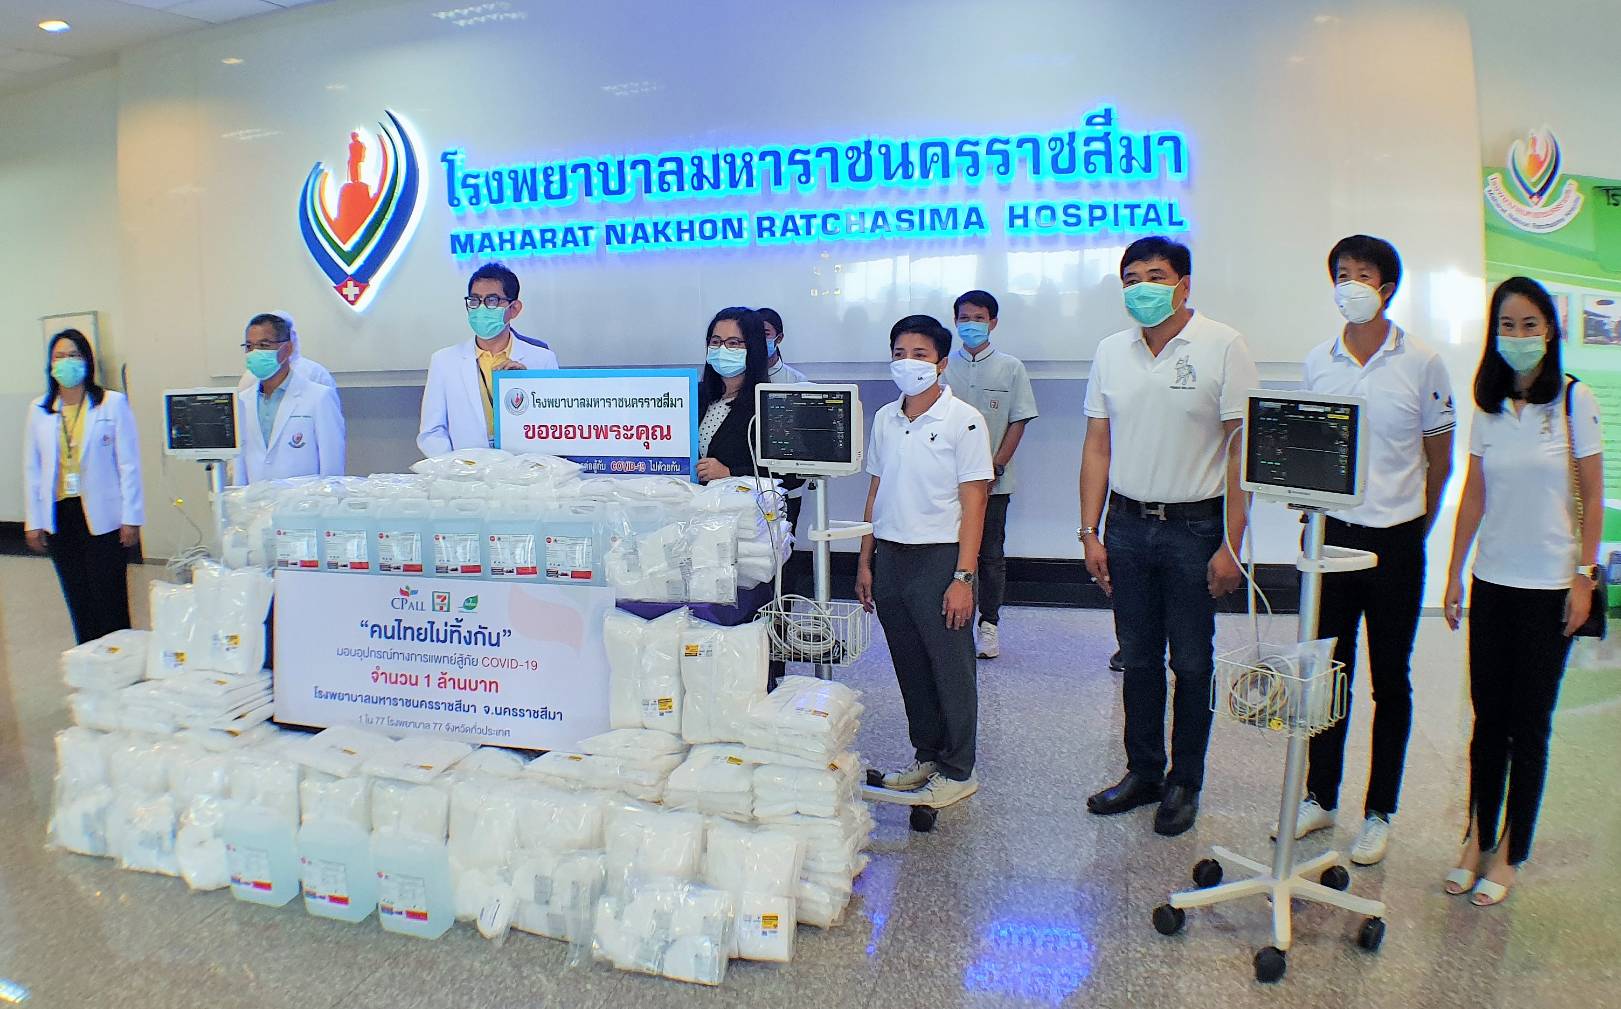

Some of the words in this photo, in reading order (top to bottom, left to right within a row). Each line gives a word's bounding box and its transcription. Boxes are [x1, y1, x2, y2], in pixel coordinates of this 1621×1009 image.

[440, 108, 1183, 208] โรงพยาบาลมหาราชนครราชสีมา
[450, 225, 595, 255] MAHARAT
[605, 216, 744, 246] NAKHON
[756, 206, 986, 238] RATCHASIMA
[1008, 202, 1184, 229] HOSPITAL
[530, 391, 684, 409] โรงพยาบาลมหาราชนครราชสีมา
[523, 423, 672, 450] ขอขอบพระคุณ
[610, 460, 647, 473] COVID-19
[336, 646, 479, 669] มอบอุปกรณ์ทางการแพทย์สู้ภัย
[481, 656, 538, 672] COVID-19
[371, 665, 419, 687] จำนวน
[424, 674, 431, 688] 1
[437, 671, 499, 694] ล้านบาท
[313, 685, 477, 714] โรงพยาบาลมหาราชนครราชสีมา
[483, 704, 563, 721] จ.นครราชสีมา
[375, 715, 386, 726] 77
[432, 721, 443, 732] 77
